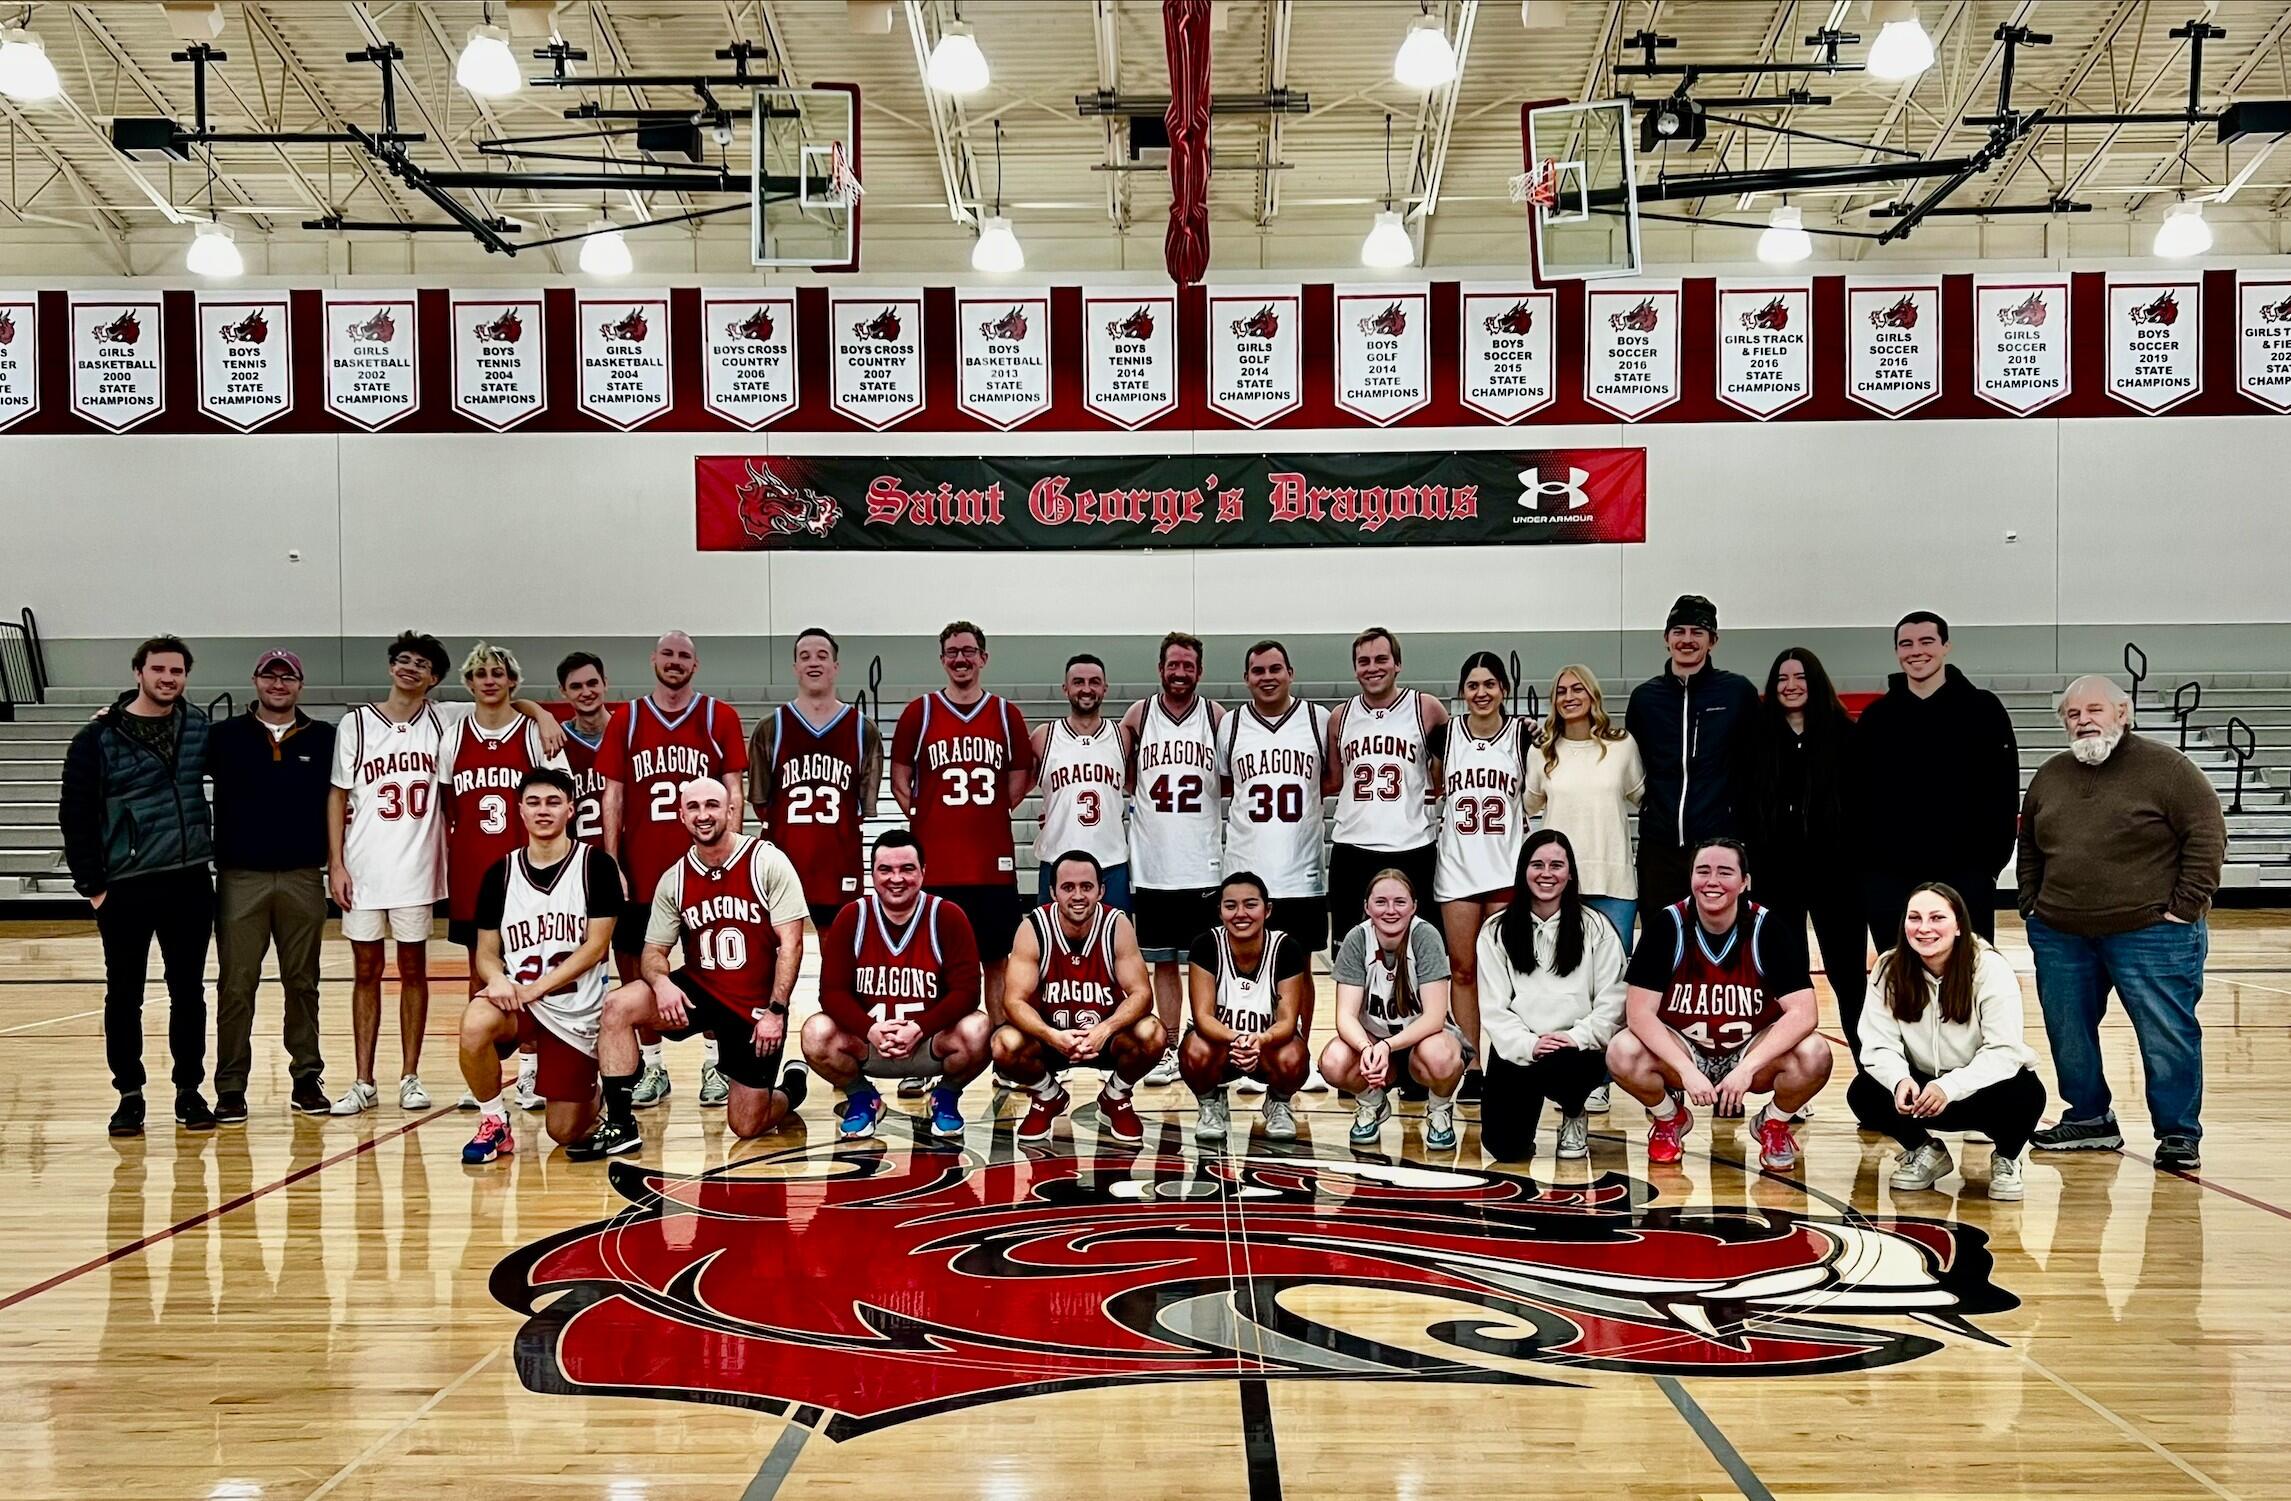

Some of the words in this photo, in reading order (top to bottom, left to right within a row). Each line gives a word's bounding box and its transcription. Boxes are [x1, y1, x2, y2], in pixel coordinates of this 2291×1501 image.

[2004, 331, 2040, 339] GIRLS
[2138, 329, 2170, 339] BOYS
[2245, 328, 2281, 337] GIRLS
[1617, 336, 1649, 345] BOYS
[1725, 335, 1760, 344] GIRLS
[1763, 334, 1804, 344] TRACK
[1876, 333, 1912, 342] GIRLS
[1115, 344, 1146, 353] BOYS
[1237, 343, 1272, 352] GIRLS
[1367, 340, 1398, 349] BOYS
[1492, 339, 1524, 349] BOYS
[1997, 343, 2046, 352] SOCCER
[2129, 341, 2179, 351] SOCCER
[2262, 340, 2271, 349] &
[2274, 339, 2291, 349] FIE
[99, 348, 135, 357] GIRLS
[229, 348, 260, 357] BOYS
[354, 347, 389, 355] GIRLS
[483, 347, 514, 356] BOYS
[606, 346, 642, 355] GIRLS
[714, 346, 745, 355] BOYS
[747, 345, 787, 354] CROSS
[840, 345, 872, 355] BOYS
[874, 345, 914, 355] CROSS
[989, 345, 1020, 354] BOYS
[1608, 348, 1657, 358] SOCCER
[1742, 348, 1750, 356] &
[1753, 347, 1787, 356] FIELD
[1869, 345, 1918, 355] SOCCER
[1108, 356, 1153, 365] TENNIS
[1239, 355, 1270, 364] GOLF
[1367, 353, 1397, 362] GOLF
[1484, 351, 1532, 361] SOCCER
[2008, 355, 2036, 364] 2018
[2139, 354, 2168, 363] 2019
[2271, 352, 2291, 361] 202
[78, 360, 157, 369] BASKETBALL
[222, 359, 267, 369] TENNIS
[334, 358, 411, 368] BASKETBALL
[476, 358, 521, 368] TENNIS
[586, 358, 663, 367] BASKETBALL
[722, 357, 779, 366] COUNTRY
[848, 357, 906, 367] COUNTRY
[966, 357, 1042, 366] BASKETBALL
[1619, 361, 1647, 370] 2016
[1750, 359, 1779, 368] 2016
[1880, 357, 1908, 366] 2016
[1117, 368, 1144, 378] 2014
[1241, 367, 1269, 376] 2014
[1369, 365, 1396, 374] 2014
[1494, 364, 1522, 373] 2015
[2003, 367, 2040, 376] STATE
[2135, 366, 2173, 375] STATE
[2266, 364, 2291, 373] STA
[103, 372, 131, 381] 2000
[231, 372, 259, 381] 2002
[358, 371, 385, 379] 2002
[485, 371, 513, 380] 2004
[611, 370, 638, 379] 2004
[737, 370, 765, 378] 2006
[864, 370, 891, 379] 2007
[992, 369, 1018, 378] 2013
[1614, 373, 1651, 382] STATE
[1746, 371, 1783, 380] STATE
[1875, 369, 1913, 379] STATE
[1237, 379, 1273, 388] STATE
[1365, 377, 1400, 386] STATE
[1490, 376, 1526, 385] STATE
[1986, 379, 2059, 389] CHAMPIONS
[2117, 378, 2191, 388] CHAMPIONS
[2248, 376, 2291, 386] CHAMP
[99, 384, 136, 393] STATE
[227, 383, 263, 393] STATE
[354, 383, 390, 392] STATE
[481, 383, 518, 392] STATE
[607, 382, 643, 391] STATE
[733, 381, 770, 391] STATE
[859, 382, 896, 391] STATE
[986, 381, 1022, 390] STATE
[1113, 381, 1149, 390] STATE
[1596, 385, 1669, 394] CHAMPIONS
[1728, 383, 1800, 392] CHAMPIONS
[1858, 381, 1931, 391] CHAMPIONS
[1219, 391, 1290, 401] CHAMPIONS
[1347, 388, 1419, 398] CHAMPIONS
[1472, 387, 1544, 397] CHAMPIONS
[82, 396, 154, 405] CHAMPIONS
[210, 395, 282, 405] CHAMPIONS
[336, 394, 408, 404] CHAMPIONS
[464, 395, 536, 404] CHAMPIONS
[589, 394, 661, 403] CHAMPIONS
[716, 393, 787, 403] CHAMPIONS
[842, 394, 914, 403] CHAMPIONS
[969, 393, 1040, 402] CHAMPIONS
[1096, 393, 1167, 402] CHAMPIONS
[864, 475, 1005, 526] Saint
[1028, 473, 1244, 535] George's
[1268, 472, 1479, 533] Dragons
[1512, 515, 1548, 524] UNDER
[1548, 514, 1594, 523] ARMOUR
[928, 736, 1003, 771] DRAGONS
[1344, 734, 1417, 766] DRAGONS
[1142, 740, 1214, 772] DRAGONS
[632, 745, 709, 783] DRAGONS
[1237, 748, 1314, 784] DRAGONS
[782, 753, 852, 791] DRAGONS
[453, 766, 523, 797] DRAGON
[1050, 763, 1121, 793] DRAGONS
[1353, 763, 1403, 802] 23
[942, 767, 996, 806] 33
[1448, 768, 1518, 798] DRAGONS
[1149, 774, 1203, 813] 42
[377, 779, 430, 822] 30
[650, 781, 690, 822] 2
[787, 785, 841, 825] 23
[1248, 783, 1304, 823] 30
[1076, 788, 1101, 827] 3
[479, 794, 507, 835] 3
[576, 798, 603, 838] 2
[1455, 795, 1506, 835] 32
[699, 927, 747, 971] 10
[856, 965, 937, 998] DRAGONS
[1667, 983, 1764, 1017] DRAGONS
[1215, 1004, 1271, 1033] RAGON
